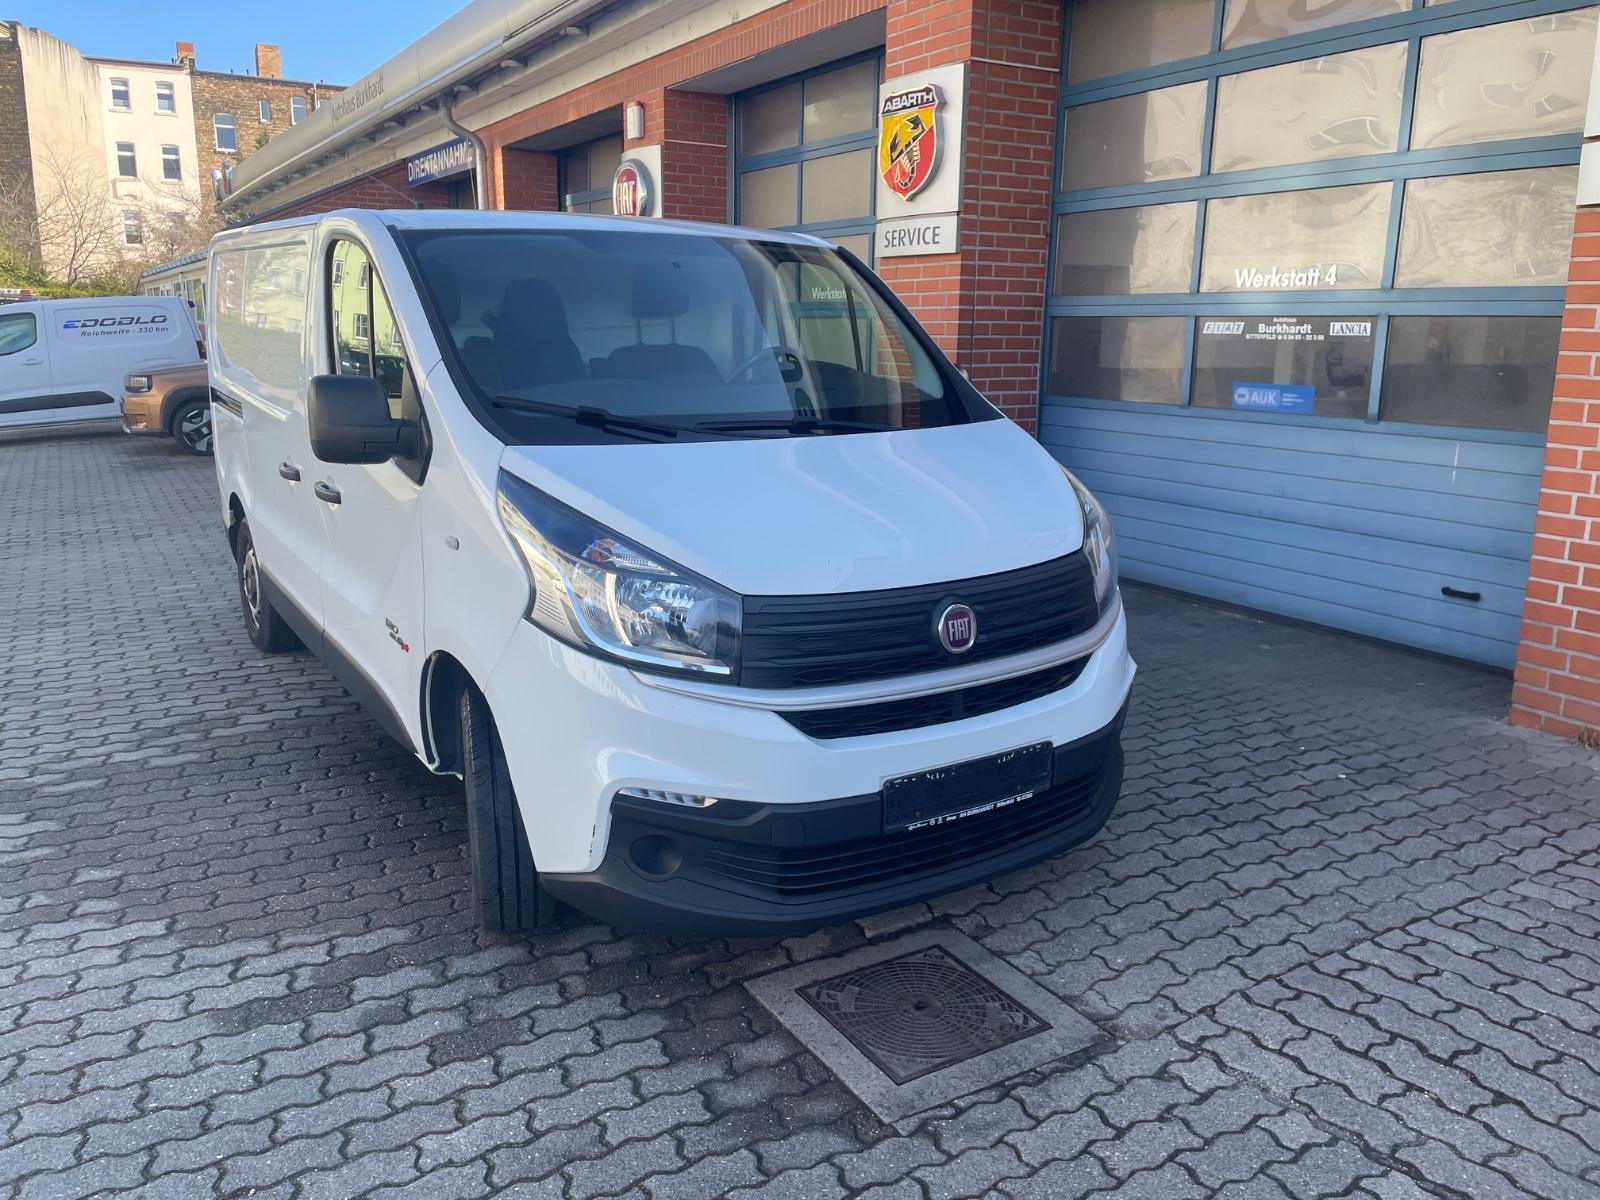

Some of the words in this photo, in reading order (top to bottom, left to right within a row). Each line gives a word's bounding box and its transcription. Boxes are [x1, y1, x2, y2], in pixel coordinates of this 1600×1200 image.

[356, 74, 385, 109] Burkhardt
[883, 91, 933, 112] ABARTH
[884, 225, 941, 249] SERVICE
[1235, 264, 1321, 289] Werkstatt
[1324, 264, 1337, 287] 4
[80, 329, 130, 337] Reichweite
[1202, 321, 1245, 335] FIAT
[1258, 323, 1312, 334] Burkhardt
[1331, 322, 1370, 335] LANCIA
[948, 617, 970, 641] FIAT
